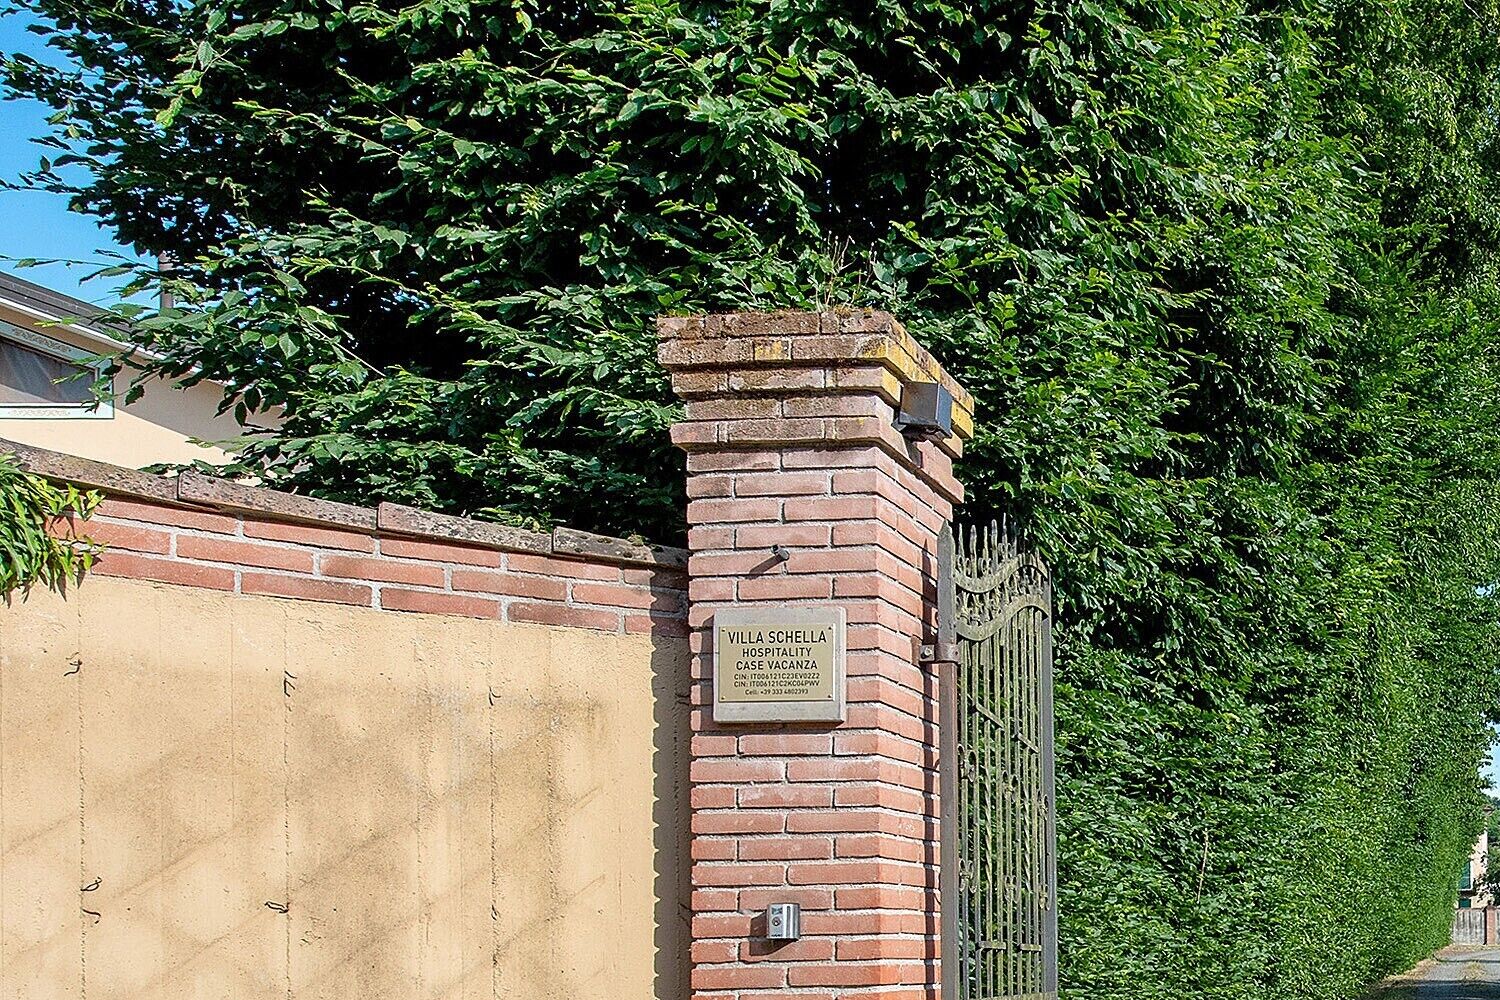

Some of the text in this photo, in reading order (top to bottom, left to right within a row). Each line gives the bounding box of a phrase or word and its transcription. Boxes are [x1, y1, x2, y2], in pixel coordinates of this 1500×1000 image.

[728, 631, 827, 644] VILLA SCHELLA
[742, 647, 812, 657] HOSPITALITY
[736, 660, 818, 671] CASE VACANZA
